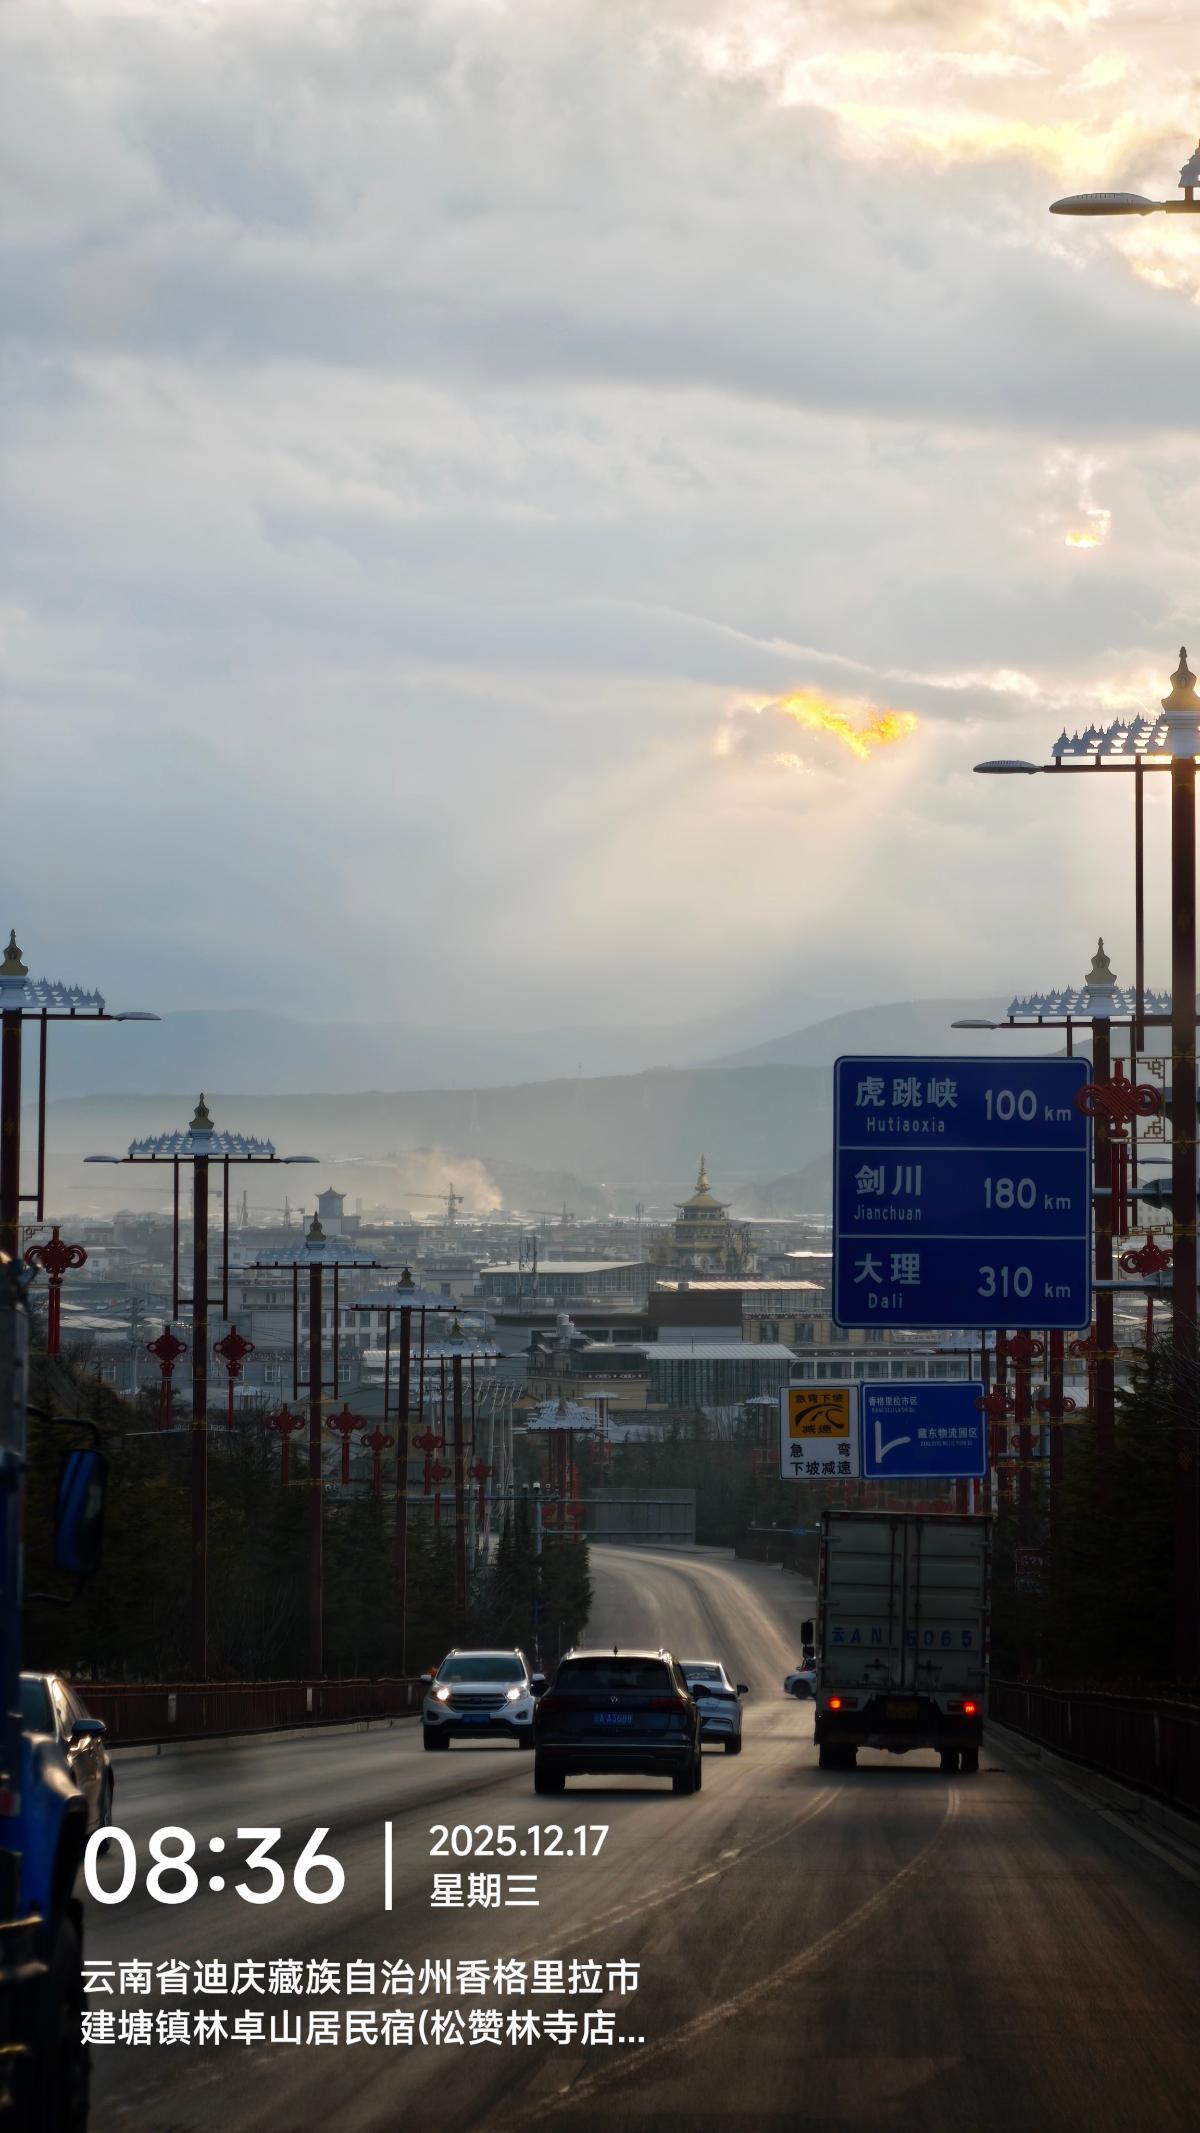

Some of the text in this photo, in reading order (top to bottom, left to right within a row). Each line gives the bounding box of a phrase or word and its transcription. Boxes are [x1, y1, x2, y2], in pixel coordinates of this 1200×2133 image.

[855, 1076, 1071, 1121] 虎跳峡 100 km
[867, 1117, 945, 1132] Hutiaoxia
[854, 1165, 1071, 1209] 剑川 180 km
[854, 1204, 922, 1220] Jianchuan
[854, 1253, 1071, 1298] 大理 310 km
[868, 1293, 903, 1309] Dali
[868, 1396, 919, 1406] 香格里拉市区
[790, 1460, 852, 1476] 下坡减速
